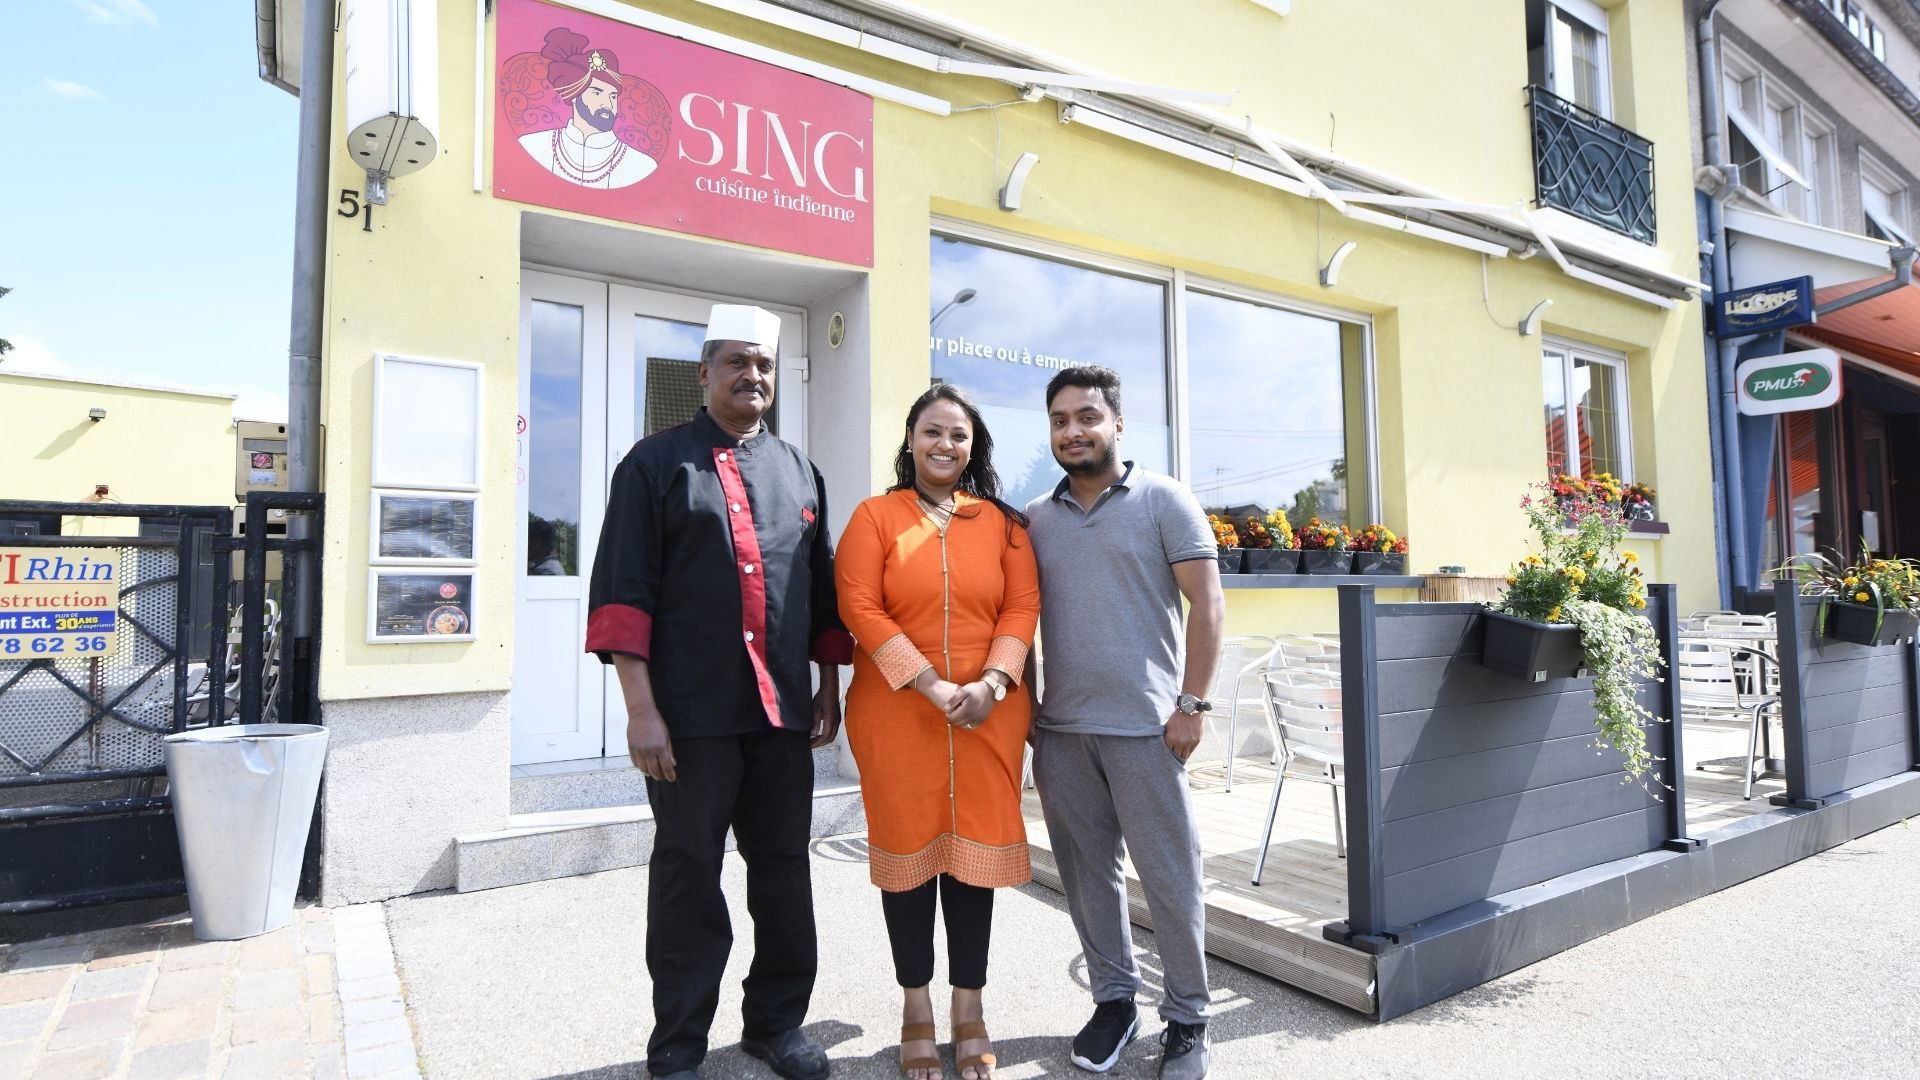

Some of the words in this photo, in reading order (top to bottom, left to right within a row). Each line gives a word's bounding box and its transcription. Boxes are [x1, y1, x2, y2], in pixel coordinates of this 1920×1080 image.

[679, 93, 869, 203] SING
[338, 189, 372, 232] 51
[696, 176, 768, 203] cuisine
[774, 188, 855, 222] indienne
[1725, 289, 1798, 315] LICORNE
[947, 336, 993, 358] place
[997, 348, 1018, 363] ou
[1022, 347, 1032, 365] à
[1753, 377, 1793, 393] PMU
[0, 554, 21, 585] I
[24, 557, 113, 581] Rhin
[21, 616, 52, 630] Ext.
[55, 617, 79, 631] 30
[77, 616, 99, 625] ANS
[0, 638, 21, 654] 8
[31, 637, 64, 653] 62
[75, 636, 107, 652] 36
